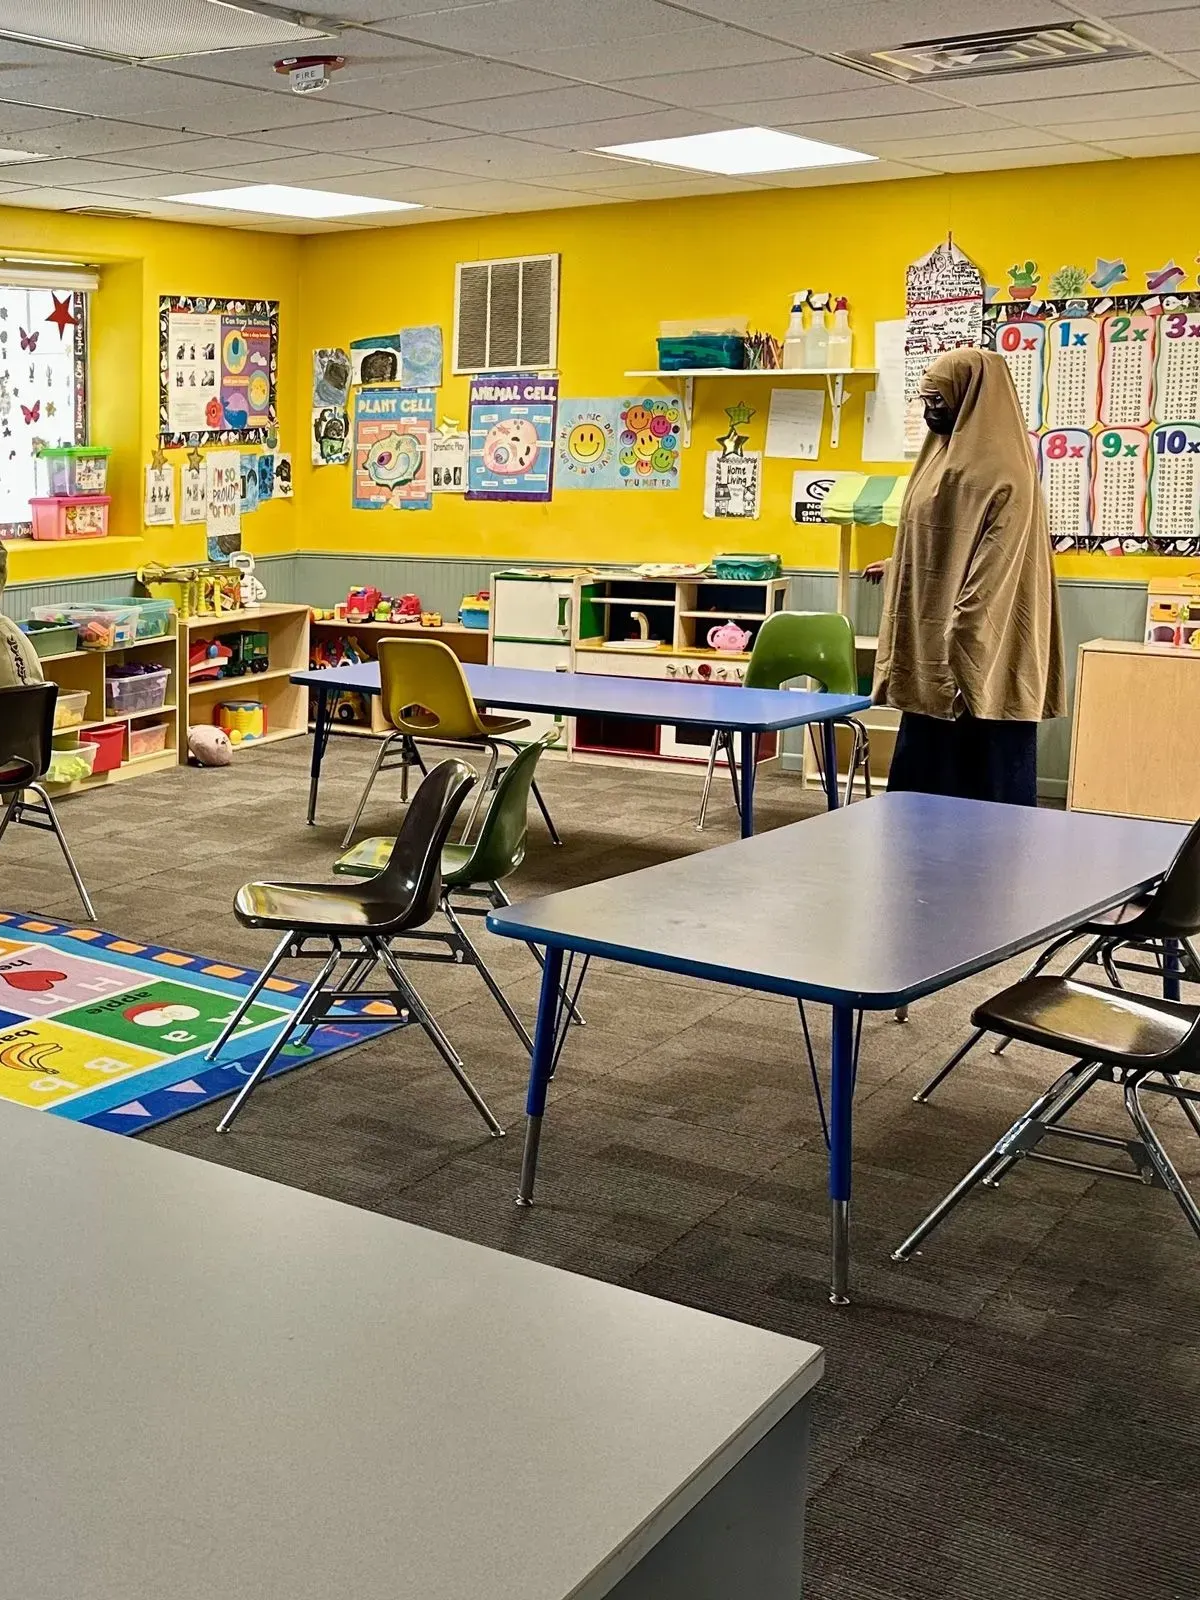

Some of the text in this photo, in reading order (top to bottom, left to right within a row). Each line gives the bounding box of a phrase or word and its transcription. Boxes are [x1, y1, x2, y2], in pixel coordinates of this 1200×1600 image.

[295, 70, 316, 80] FIRE
[1058, 322, 1090, 347] 1x
[1110, 317, 1149, 343] 2x
[1165, 313, 1200, 338] 3x
[1001, 326, 1039, 352] 0x
[470, 386, 557, 402] ANIMAL CELL
[358, 399, 434, 414] PLANT CELL
[434, 442, 464, 452] Dramatic Play
[1046, 434, 1086, 460] 8x
[1102, 432, 1140, 458] 9x
[1155, 430, 1200, 455] 10x
[214, 468, 224, 486] I'M
[225, 468, 236, 482] SO
[726, 464, 747, 475] Home
[624, 478, 672, 488] YOU MATTER
[726, 476, 747, 488] Living
[212, 484, 236, 502] PROUD
[223, 503, 236, 516] YOU
[76, 976, 126, 992] H
[86, 990, 154, 1016] apple
[28, 1056, 133, 1093] B b
